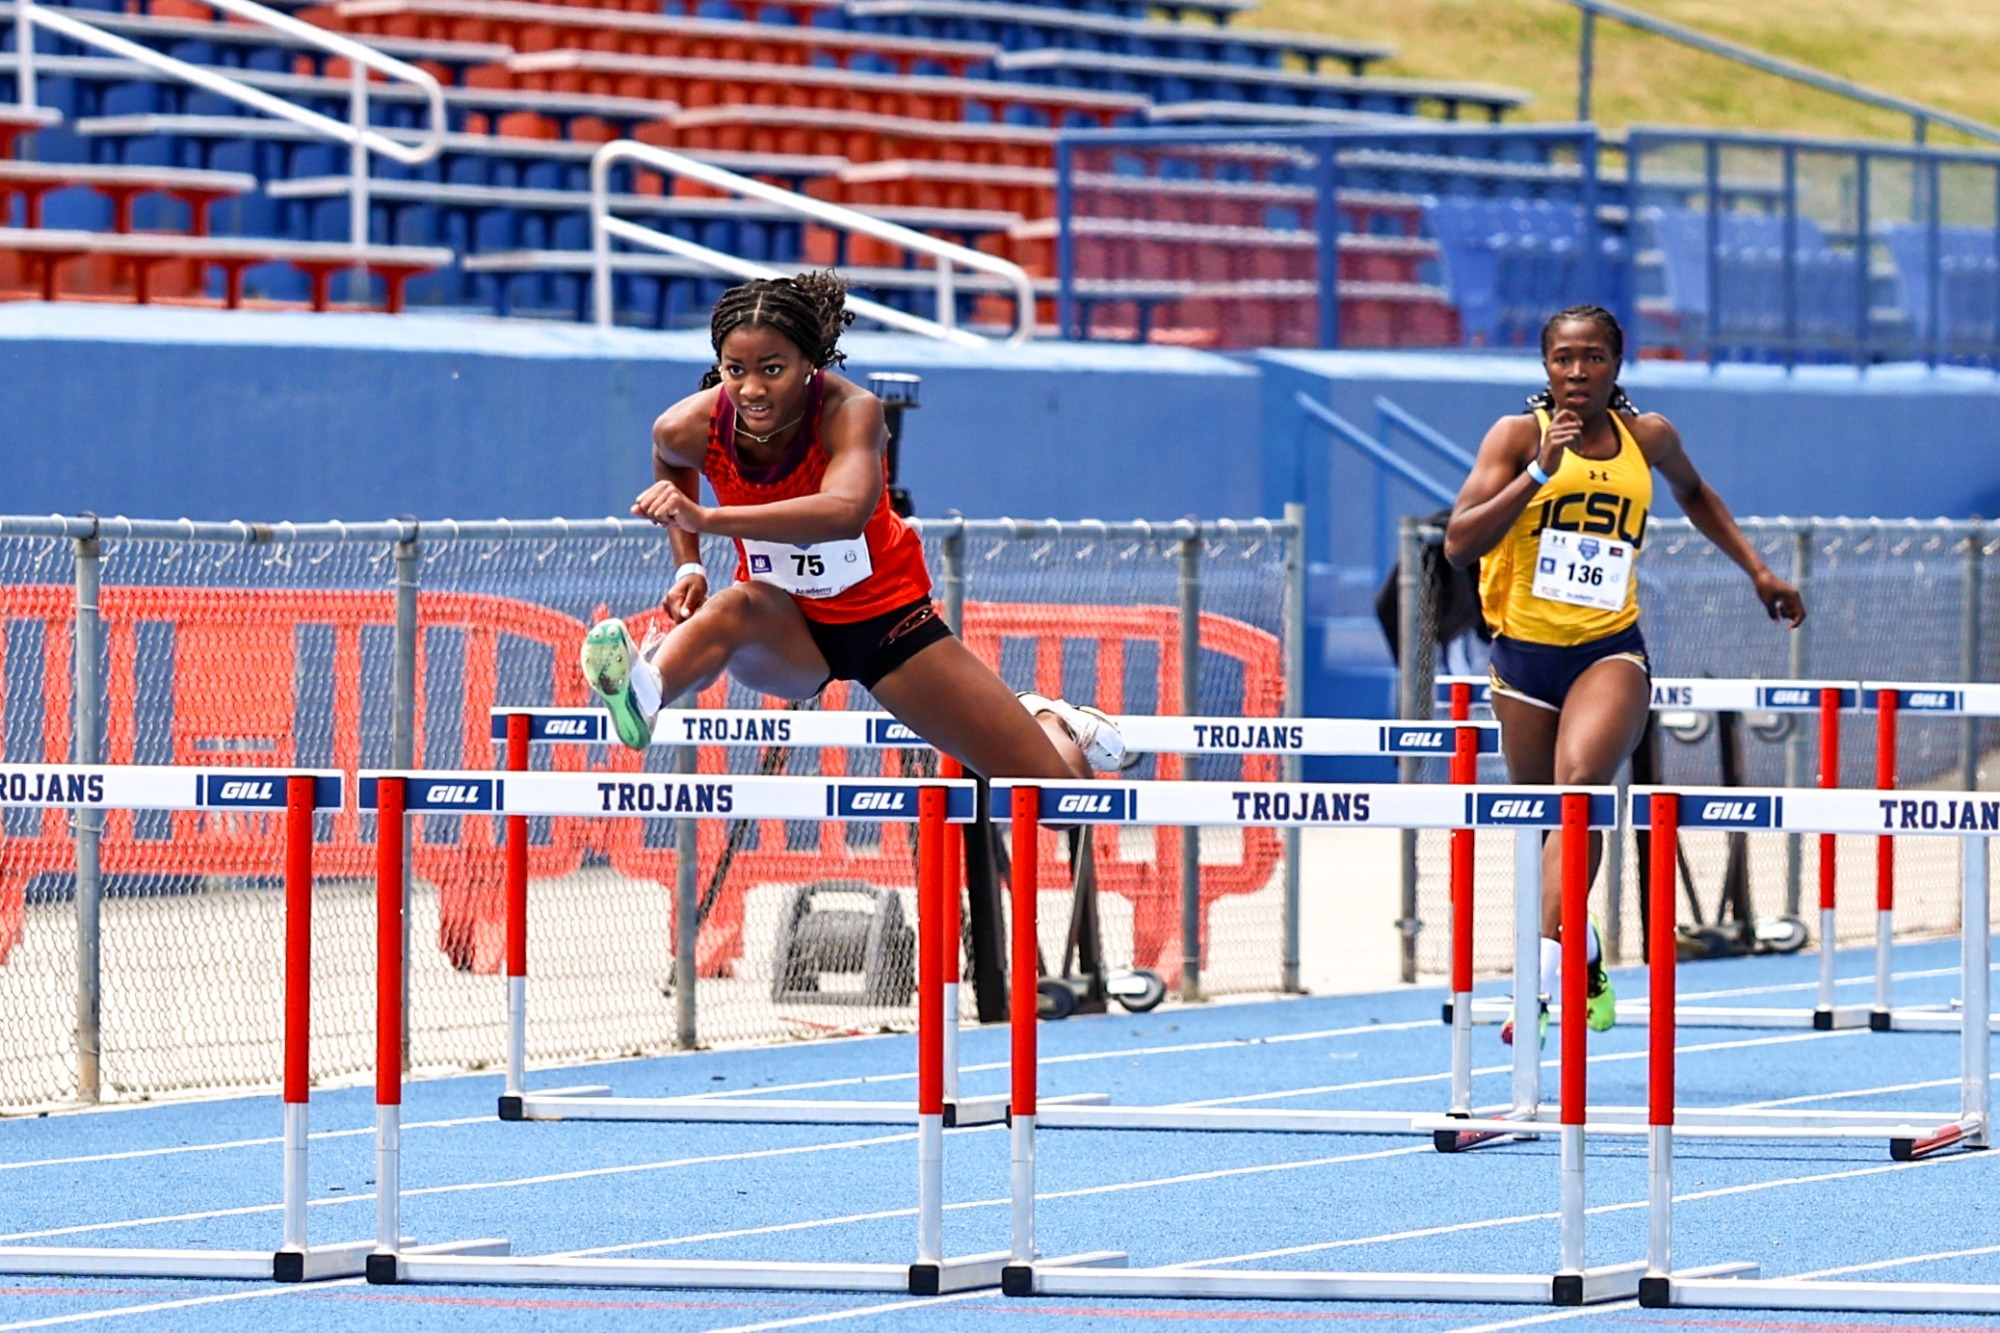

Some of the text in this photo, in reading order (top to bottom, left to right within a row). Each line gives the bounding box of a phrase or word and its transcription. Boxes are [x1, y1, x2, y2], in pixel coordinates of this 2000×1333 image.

[1529, 491, 1647, 549] JCSU
[790, 554, 825, 576] 75
[1567, 561, 1604, 586] 136
[1772, 690, 1810, 705] GILL
[1909, 693, 1947, 708] GILL
[544, 720, 587, 735] GILL
[683, 717, 791, 741] TROJANS
[1194, 724, 1303, 748] TROJANS
[1399, 732, 1443, 747] GILL
[220, 781, 273, 800] GILL
[426, 785, 479, 803] GILL
[598, 783, 733, 812] TROJANS
[851, 792, 905, 810] GILL
[1058, 794, 1112, 813] GILL
[1233, 792, 1370, 822] TROJANS
[1490, 800, 1545, 818] GILL
[1702, 802, 1757, 820] GILL
